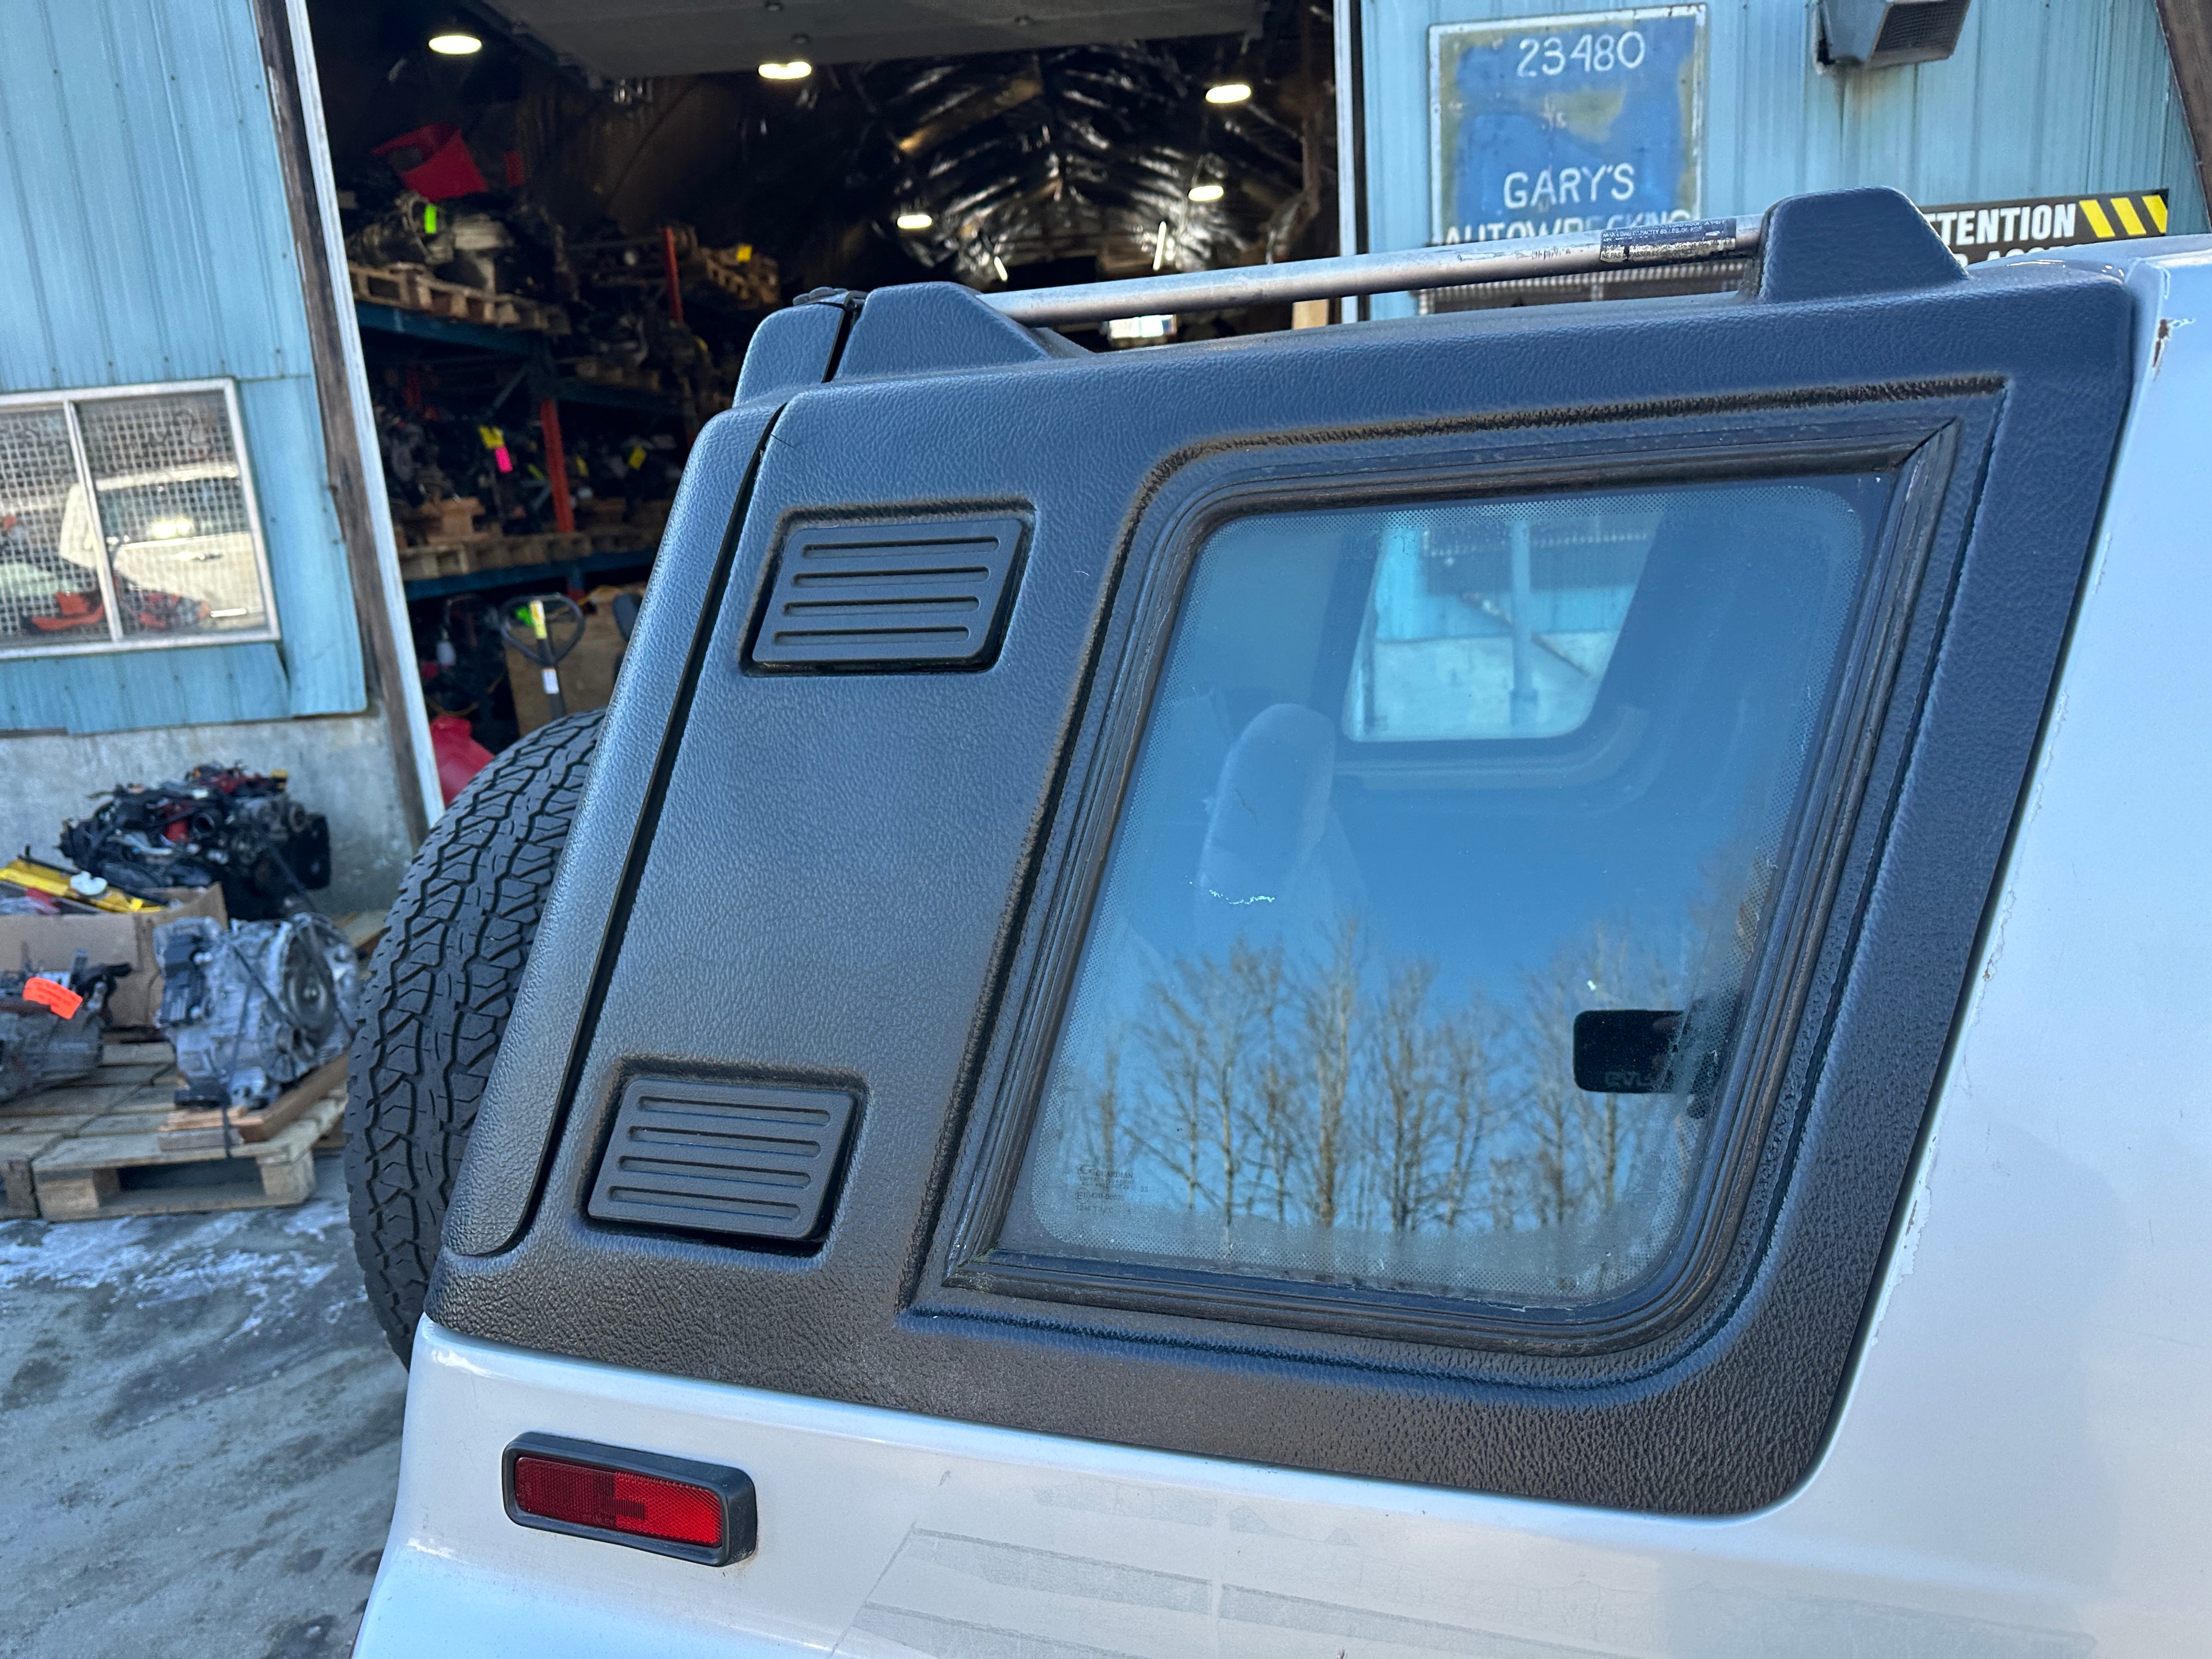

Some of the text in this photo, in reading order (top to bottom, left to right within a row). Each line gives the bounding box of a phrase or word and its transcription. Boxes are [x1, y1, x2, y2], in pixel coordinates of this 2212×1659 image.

[1517, 31, 1645, 77] 23480
[1503, 164, 1634, 209] GARY'S
[1924, 203, 2076, 245] TENTION
